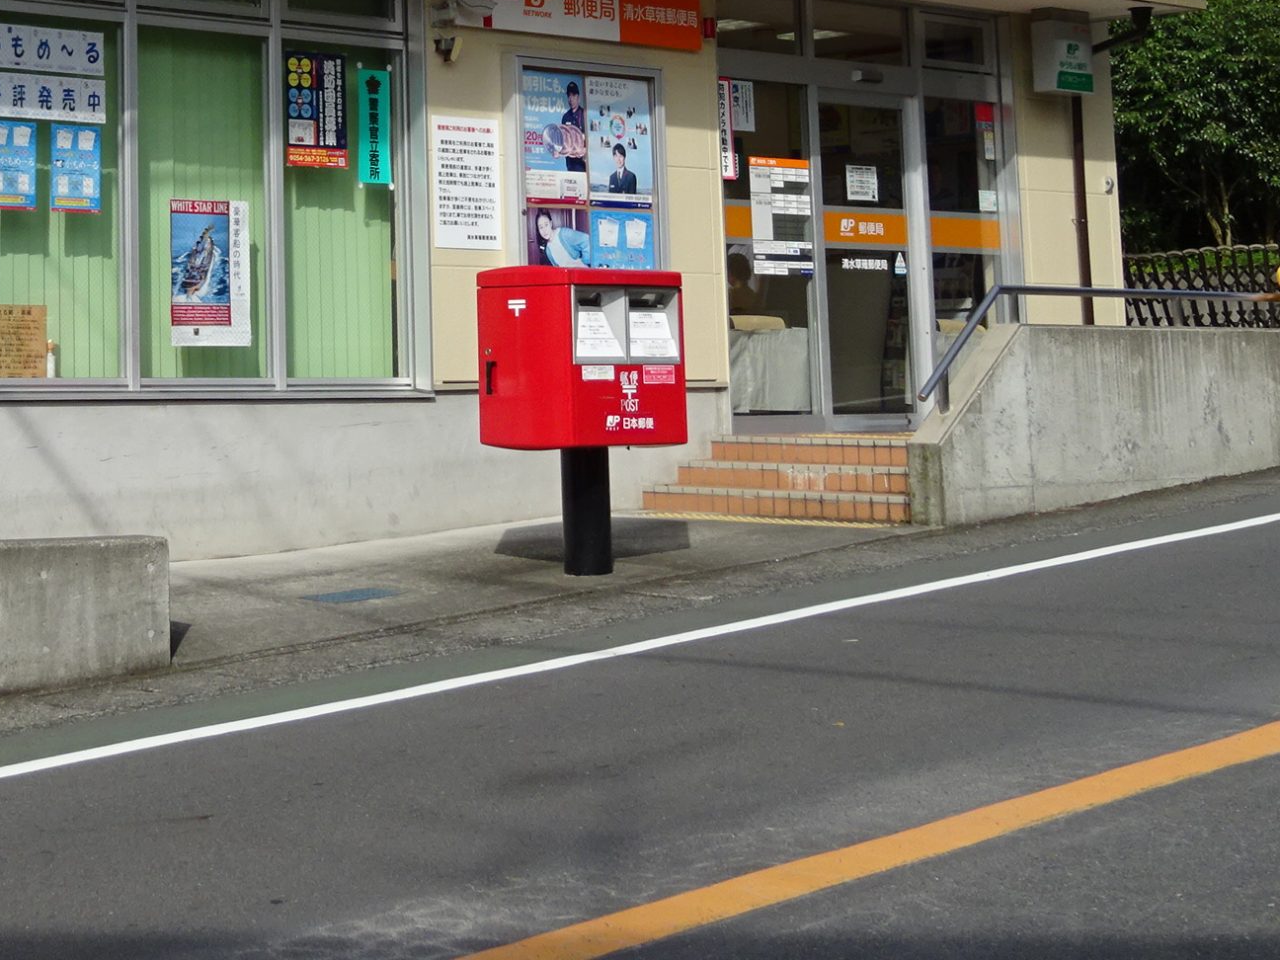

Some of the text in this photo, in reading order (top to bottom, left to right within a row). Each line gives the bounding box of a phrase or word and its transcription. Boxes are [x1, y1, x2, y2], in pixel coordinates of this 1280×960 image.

[523, 9, 552, 19] NETWORK
[623, 3, 698, 28] 清水草薙郵便局
[368, 98, 380, 181] 警察官立寄所
[171, 201, 229, 214] WHITE STAR LINE
[858, 221, 884, 236] 郵便局
[620, 399, 639, 412] POST
[623, 418, 654, 429] 日本郵便
